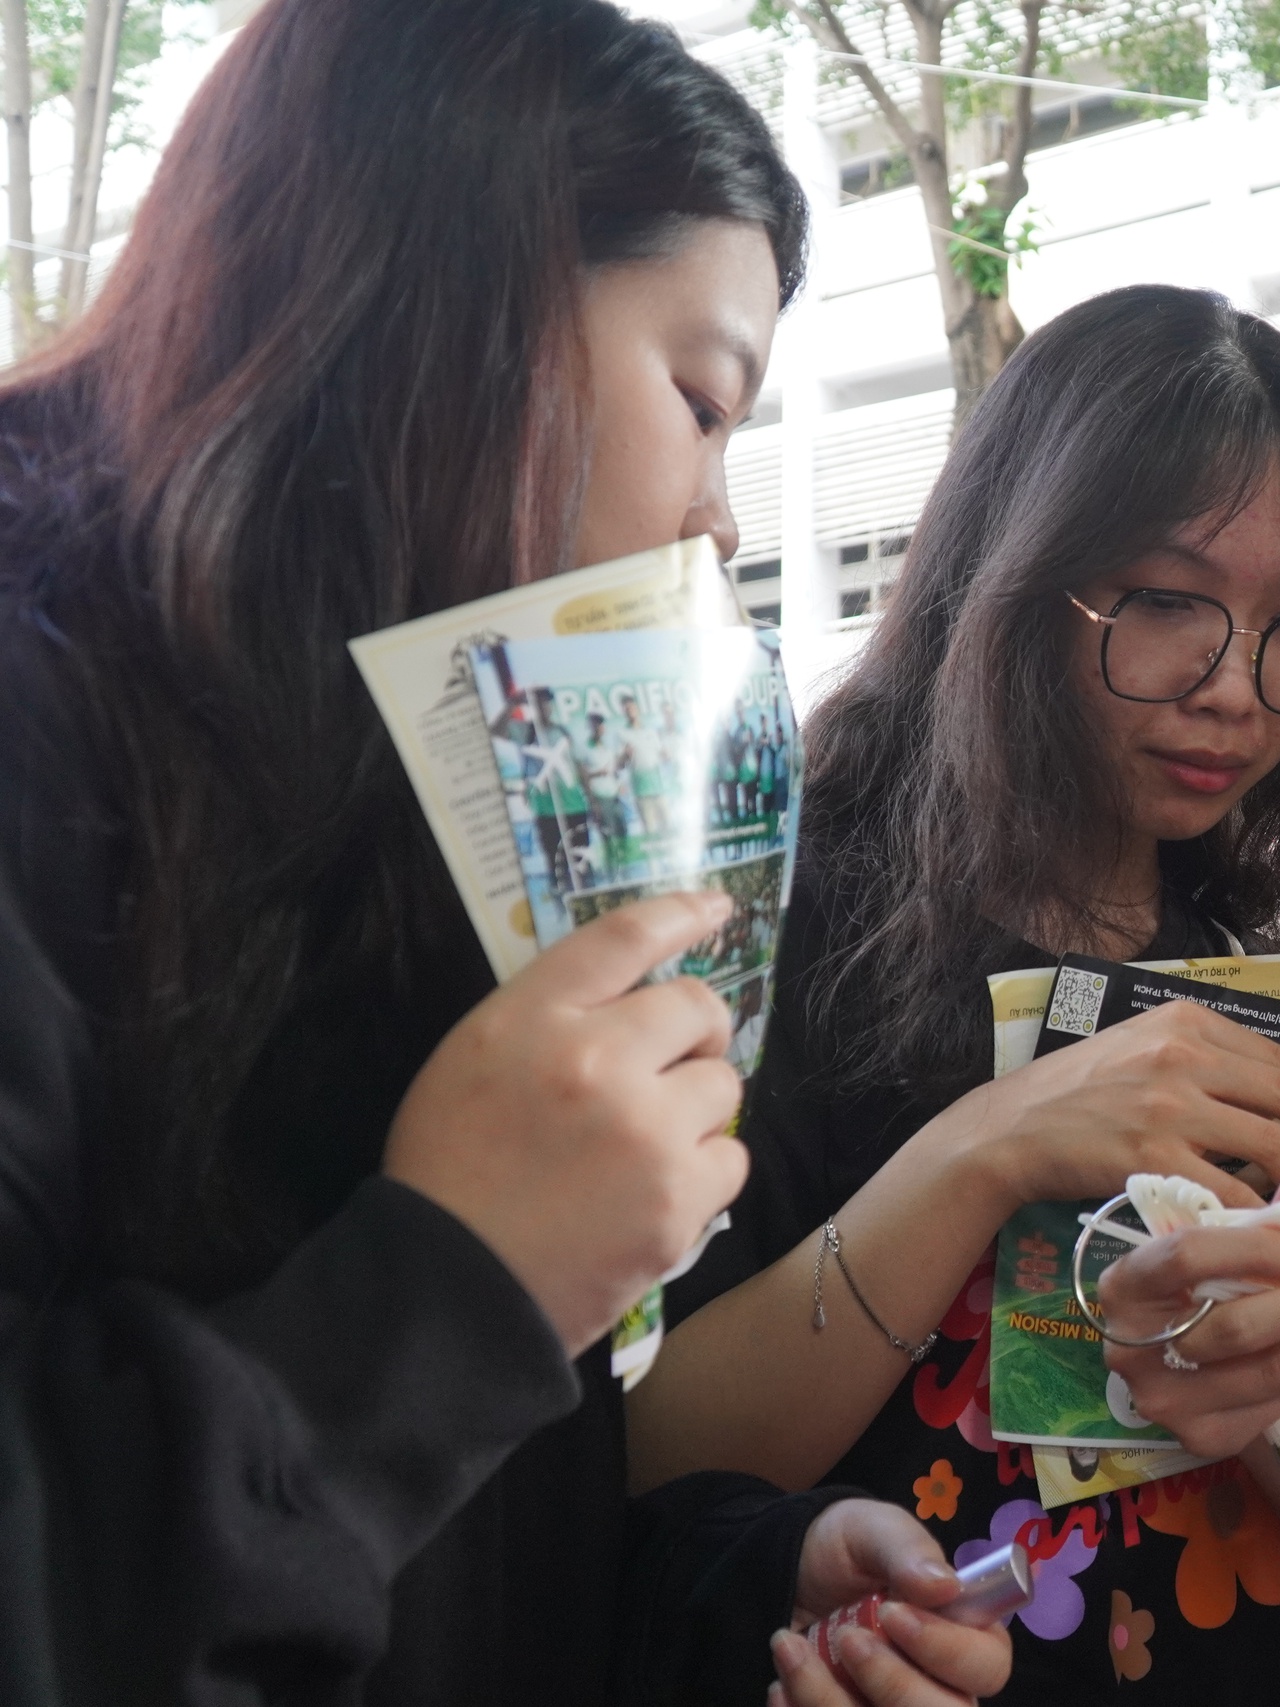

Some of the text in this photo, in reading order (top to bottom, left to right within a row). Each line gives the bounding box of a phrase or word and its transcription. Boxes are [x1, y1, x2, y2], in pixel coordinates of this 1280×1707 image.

[742, 675, 784, 709] OUP
[1133, 983, 1162, 998] TP.HCM
[1232, 1003, 1259, 1019] Đường
[1009, 1312, 1080, 1340] MISSION
